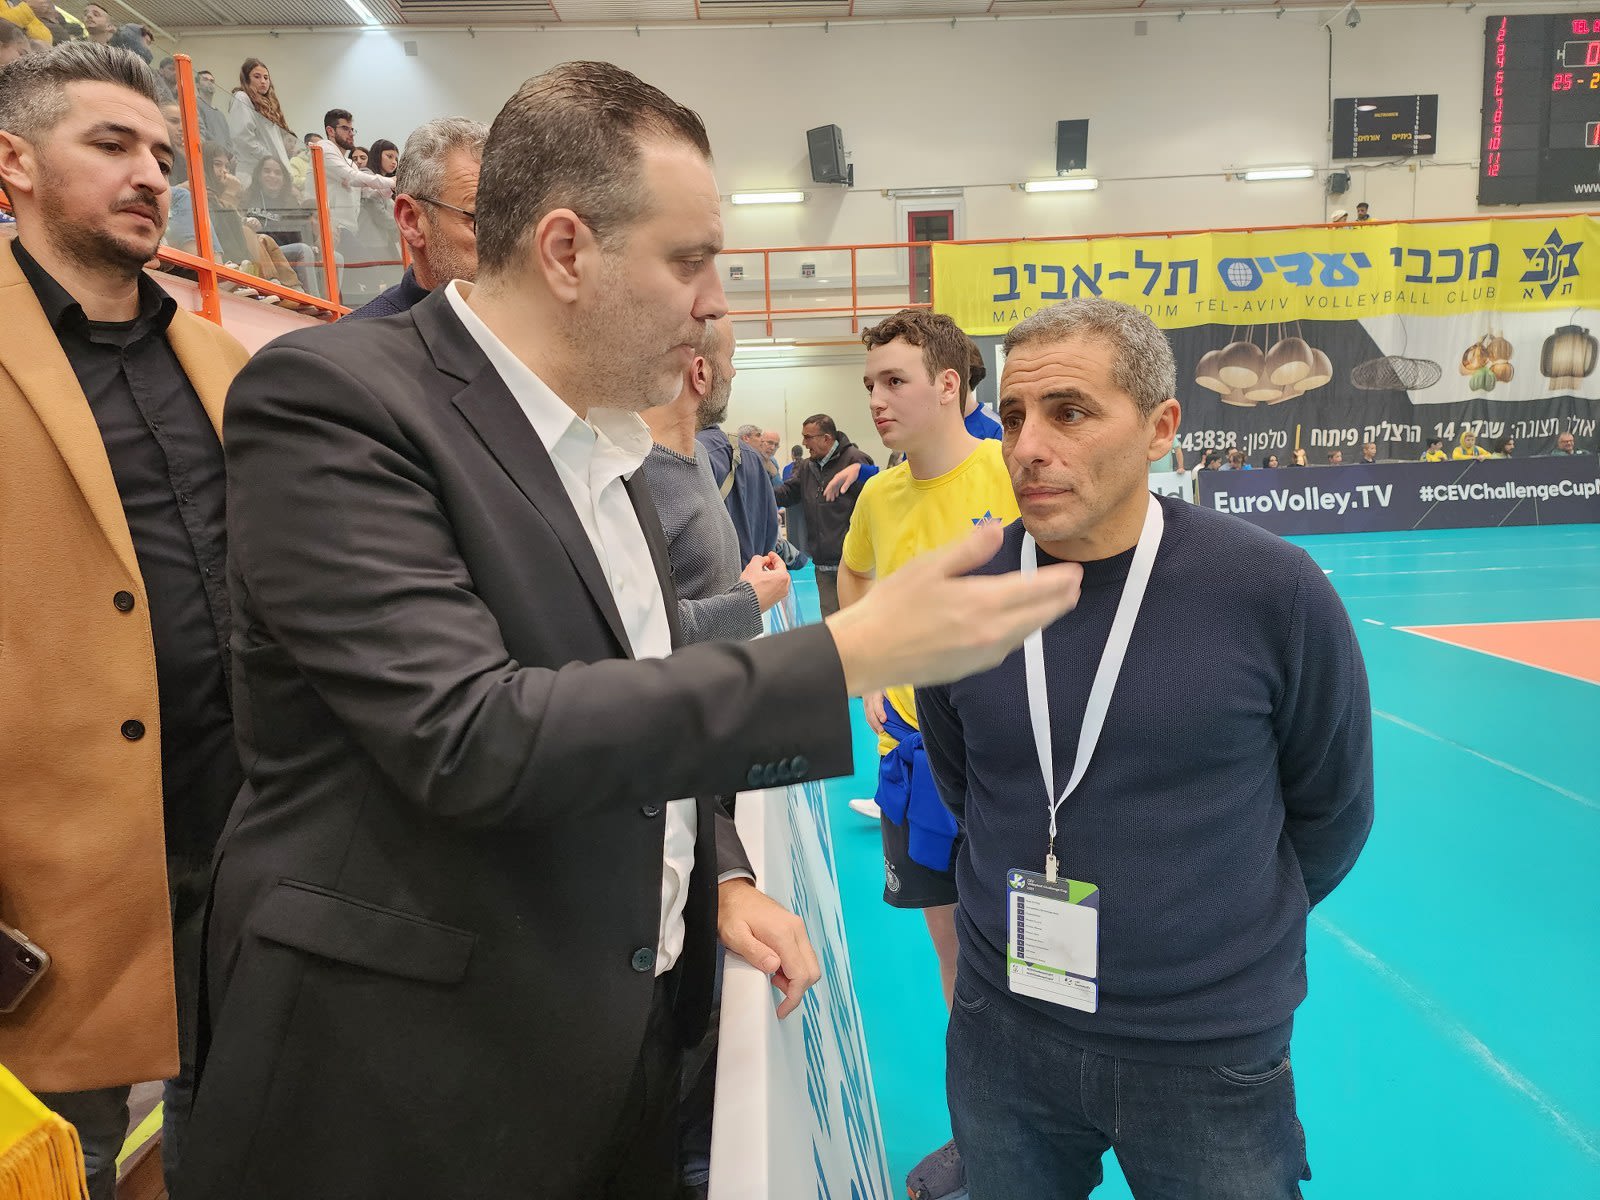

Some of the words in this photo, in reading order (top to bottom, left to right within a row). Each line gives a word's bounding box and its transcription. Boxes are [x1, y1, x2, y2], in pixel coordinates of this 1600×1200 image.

[1552, 73, 1573, 90] 25
[1217, 252, 1372, 291] יעדים
[1390, 243, 1499, 283] מכבי
[993, 250, 1198, 302] תל-אביב
[993, 306, 1033, 323] MAC
[1195, 297, 1289, 313] TEL-AVIV
[1305, 290, 1429, 308] VOLLEYBALL
[1446, 287, 1495, 304] CLUB
[1176, 430, 1237, 452] 43838
[1311, 427, 1358, 447] פיתוח
[1363, 420, 1421, 443] הרצליה
[1434, 421, 1455, 442] 14
[1461, 420, 1504, 439] שנקר
[1214, 484, 1393, 515] EuroVolley.TV
